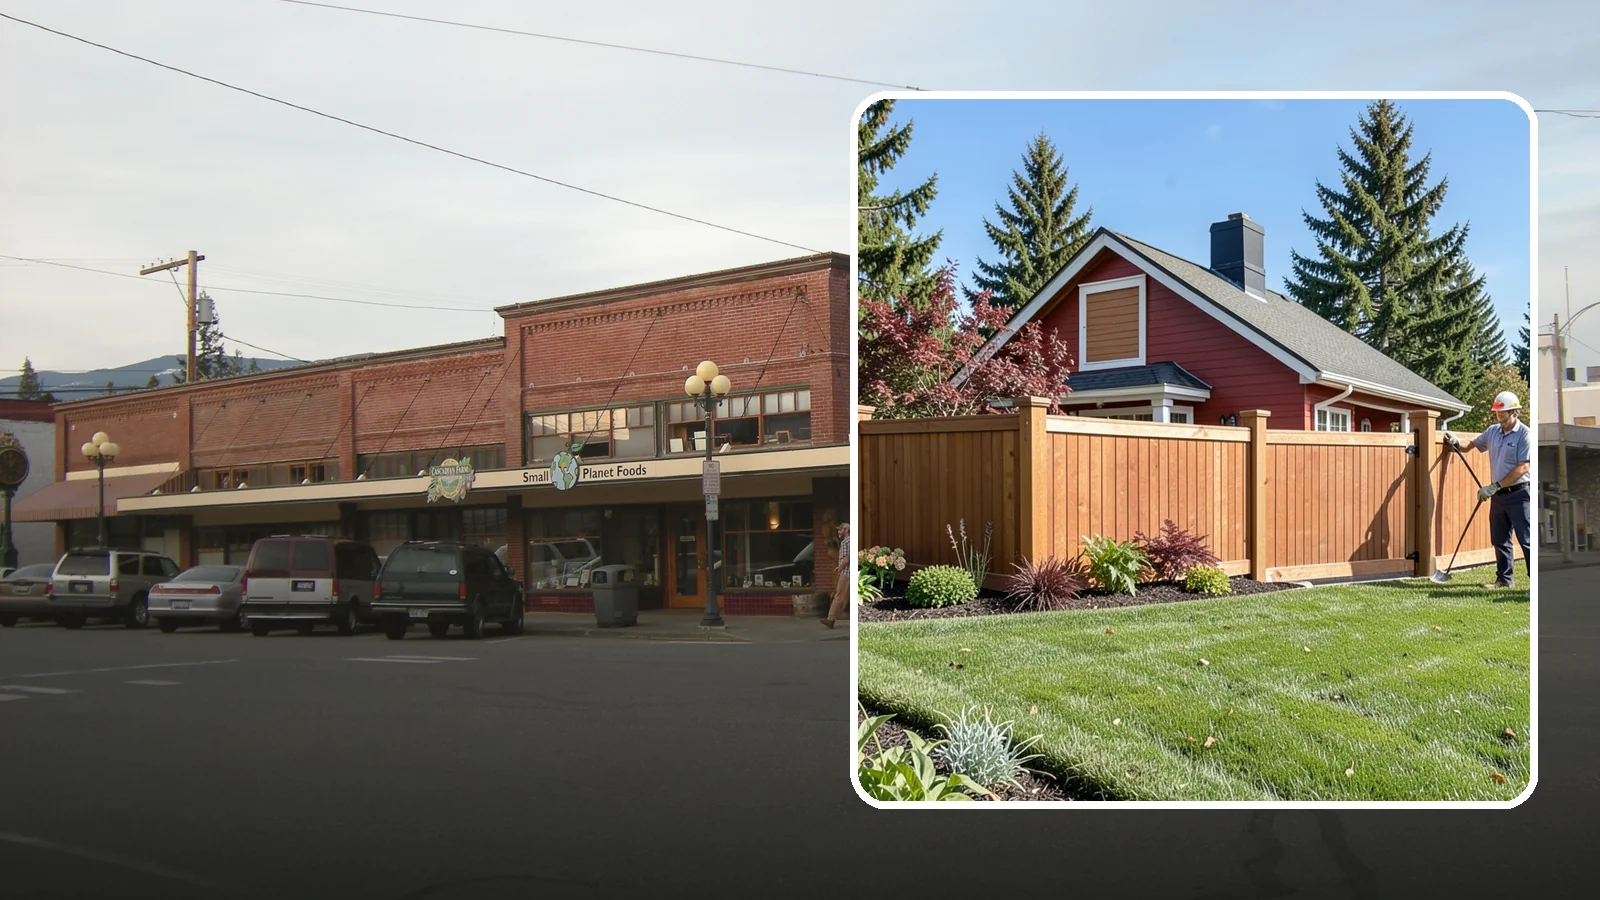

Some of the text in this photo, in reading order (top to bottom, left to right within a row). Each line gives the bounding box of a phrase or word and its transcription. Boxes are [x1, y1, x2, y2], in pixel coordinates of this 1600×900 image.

[523, 464, 647, 483] Small Planet Foods
